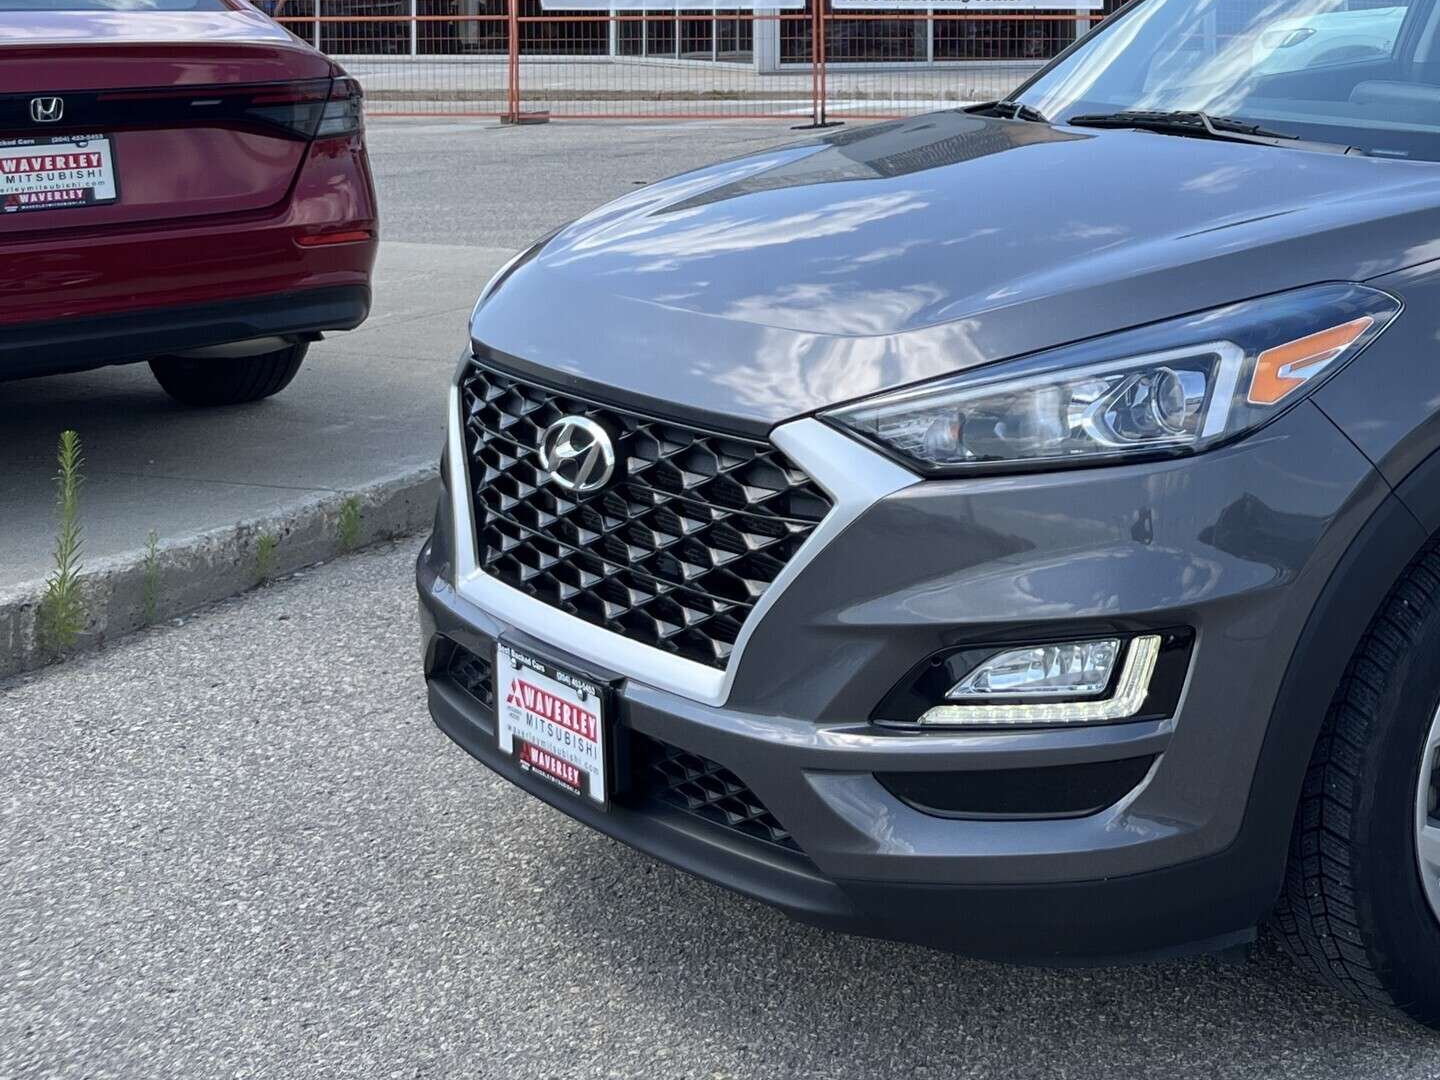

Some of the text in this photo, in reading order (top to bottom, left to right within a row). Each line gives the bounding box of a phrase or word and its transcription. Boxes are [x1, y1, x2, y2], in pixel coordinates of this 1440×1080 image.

[2, 153, 99, 172] WAVERLEY
[6, 169, 103, 184] MITSUBISHI
[19, 189, 84, 203] WAVERLEY
[524, 685, 597, 738] WAVERLEY
[526, 713, 597, 760] MITSUBISHI
[530, 746, 579, 784] WAVERLEY
